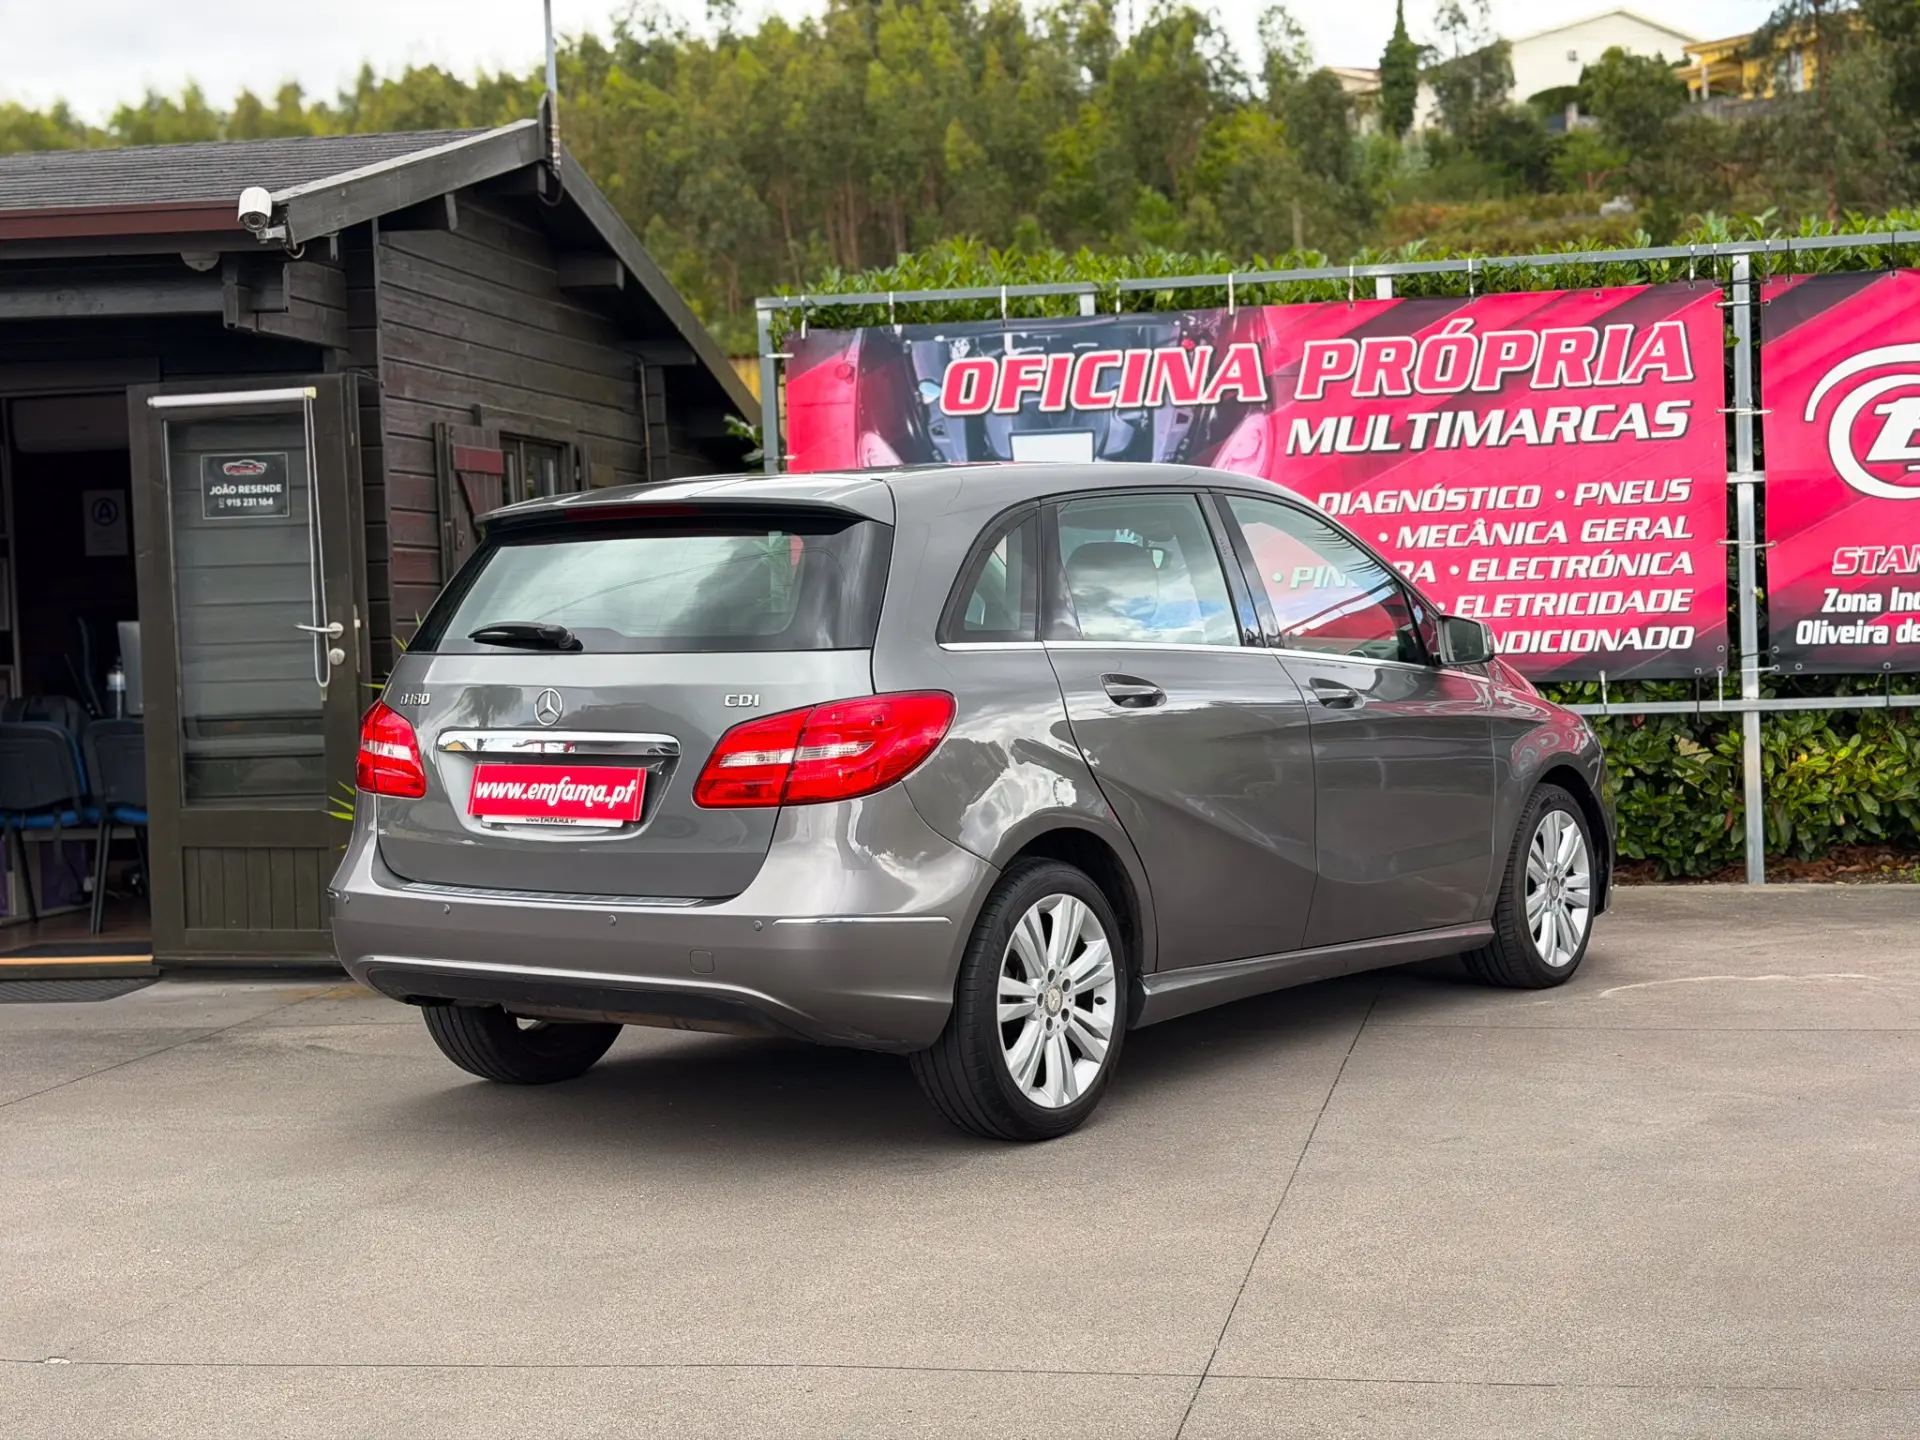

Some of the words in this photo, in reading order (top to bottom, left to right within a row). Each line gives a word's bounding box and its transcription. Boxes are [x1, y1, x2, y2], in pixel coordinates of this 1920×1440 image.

[940, 343, 1267, 416] OFICINA
[1294, 318, 1695, 401] PRÓPRIA
[1286, 400, 1691, 456] MULTIMARCAS
[209, 483, 237, 495] JOÃO
[238, 484, 282, 494] RESENDE
[1318, 484, 1542, 516] DIAGNÓSTICO
[1573, 478, 1692, 507] PNEUS
[1396, 519, 1568, 549] MECÂNICA
[1581, 516, 1694, 543] GERAL
[1467, 549, 1694, 583] ELECTRÓNICA
[1454, 588, 1695, 618] ELETRICIDADE
[1821, 588, 1883, 613] Zona
[1796, 619, 1889, 645] Oliveira
[724, 694, 760, 707] CDI
[475, 776, 637, 809] www.emfama.pt
